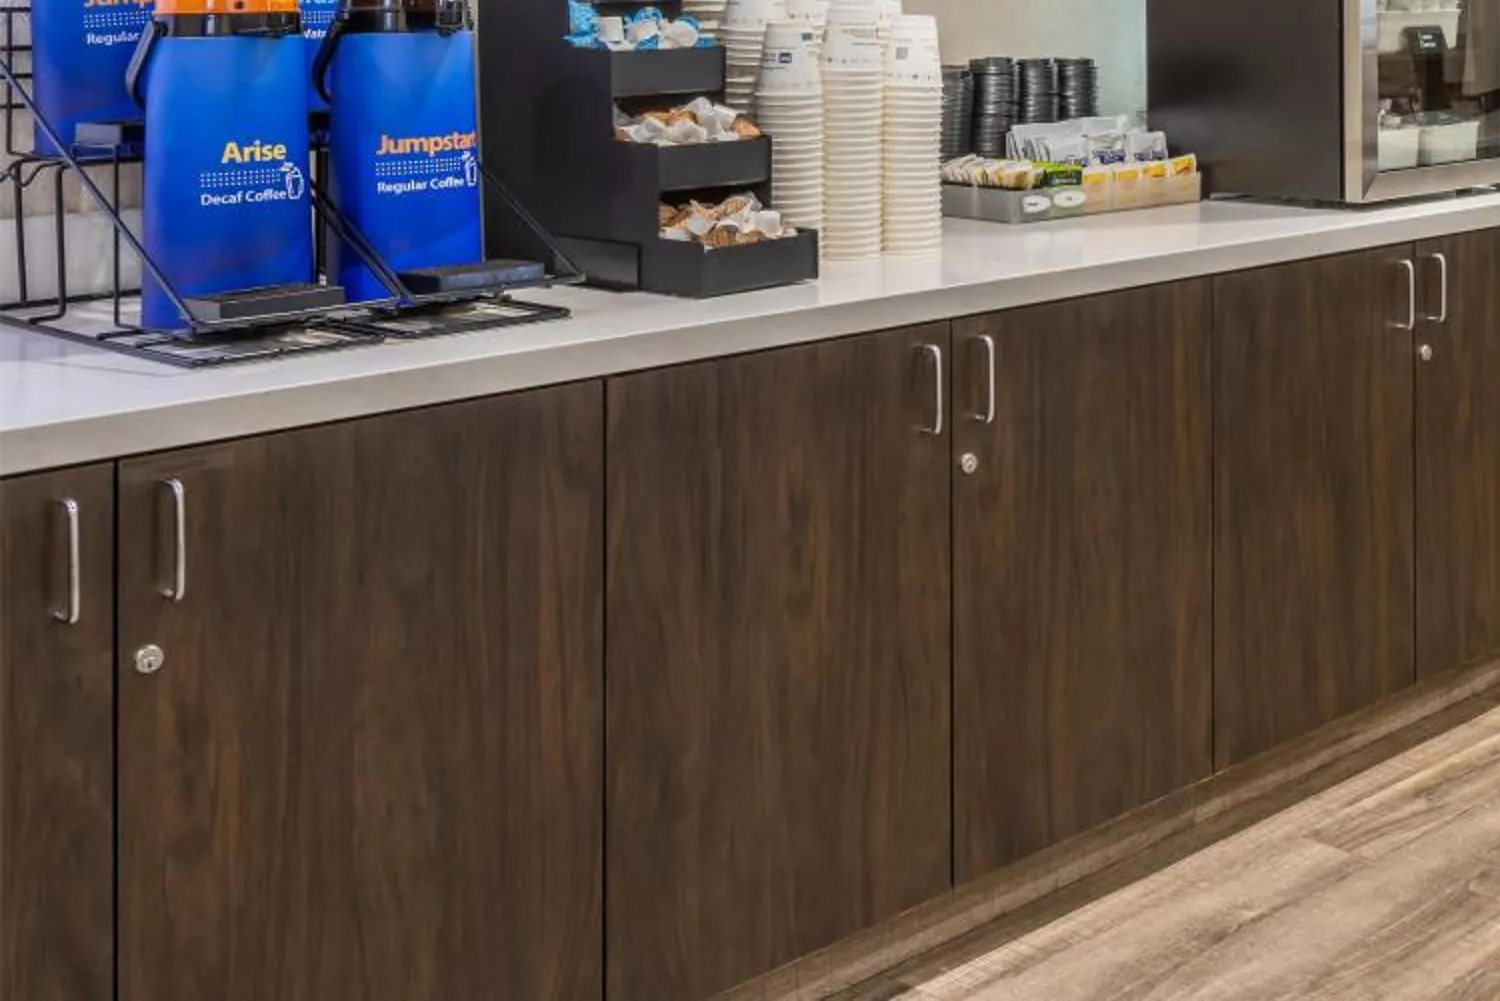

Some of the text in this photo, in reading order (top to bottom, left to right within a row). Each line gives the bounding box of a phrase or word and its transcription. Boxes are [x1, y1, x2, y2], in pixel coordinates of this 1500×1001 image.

[86, 31, 140, 46] Regular
[221, 140, 287, 164] Arise
[377, 177, 464, 195] Regular Coffee
[201, 188, 287, 206] Decaf Coffee
